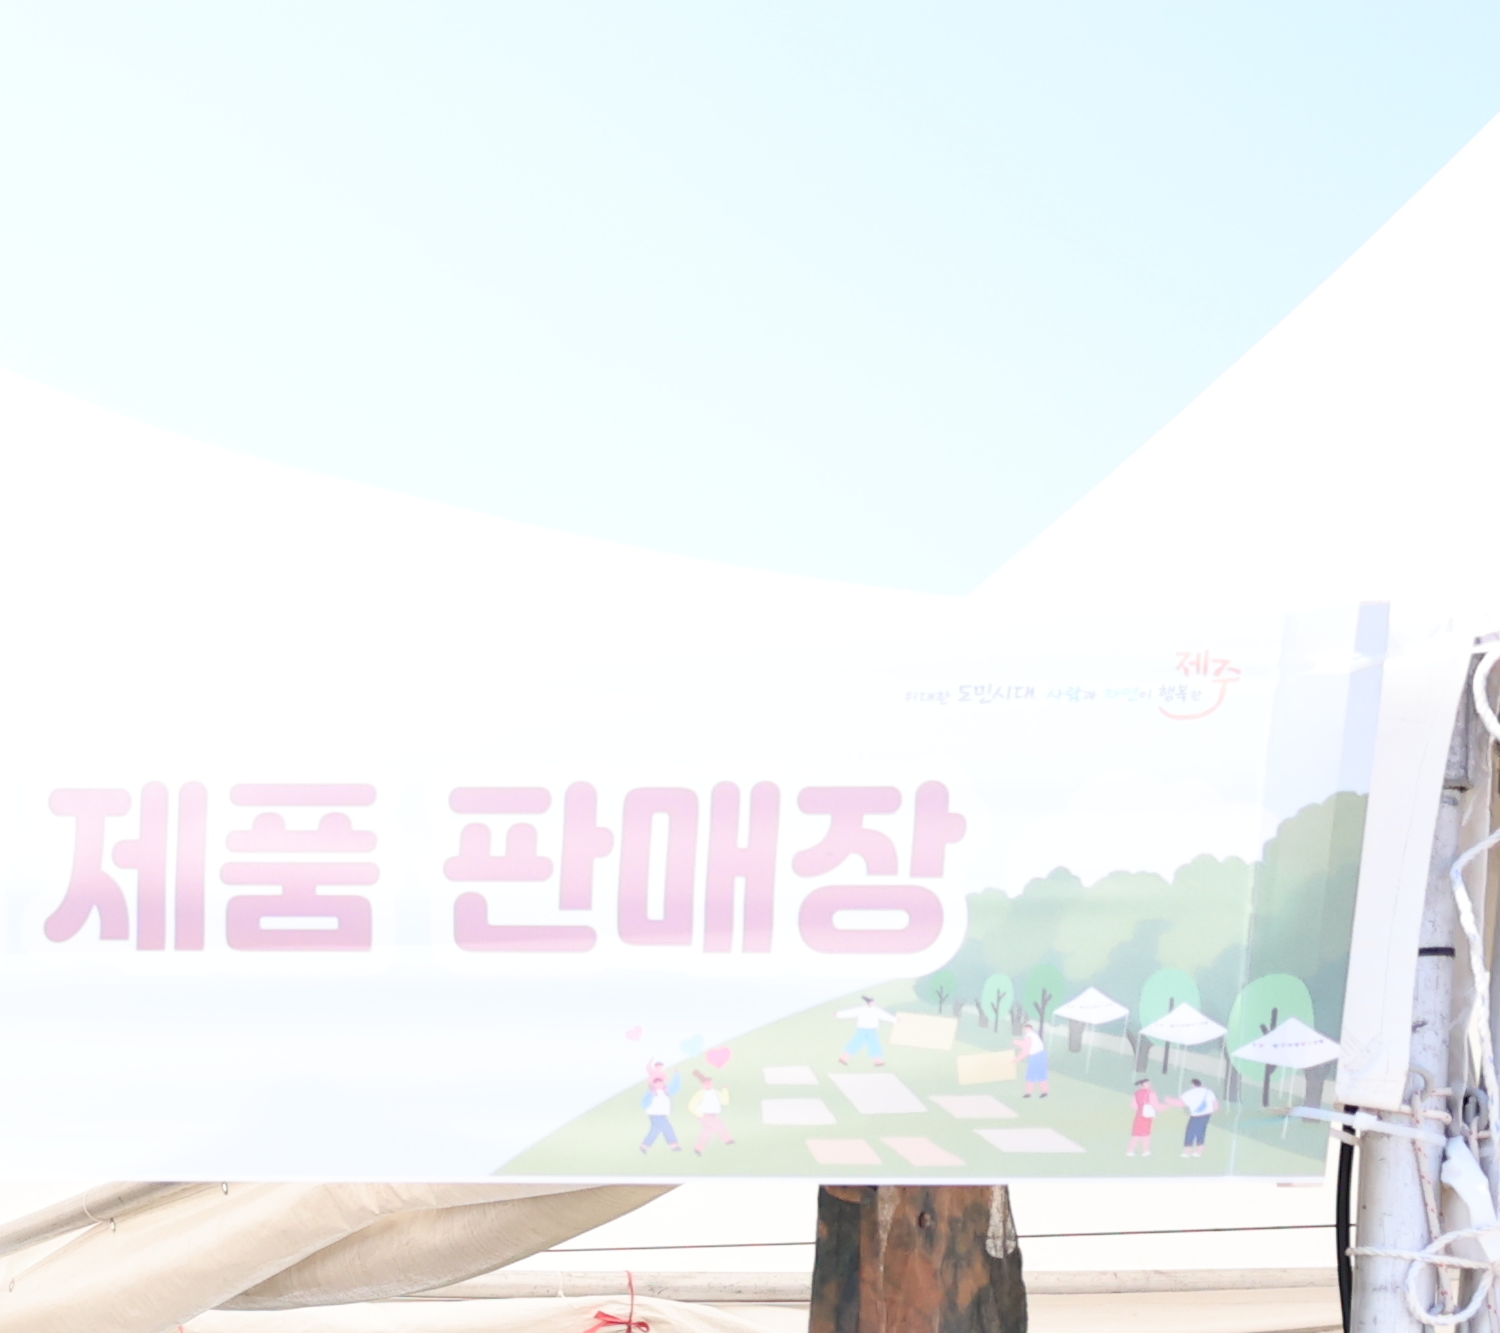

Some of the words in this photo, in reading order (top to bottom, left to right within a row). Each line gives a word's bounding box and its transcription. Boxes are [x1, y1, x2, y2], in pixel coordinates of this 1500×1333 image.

[1047, 685, 1097, 702] 사람과
[1158, 649, 1241, 720] 제주
[1158, 683, 1202, 702] 행복한
[45, 780, 380, 953] 제품
[442, 780, 967, 955] 판매장
